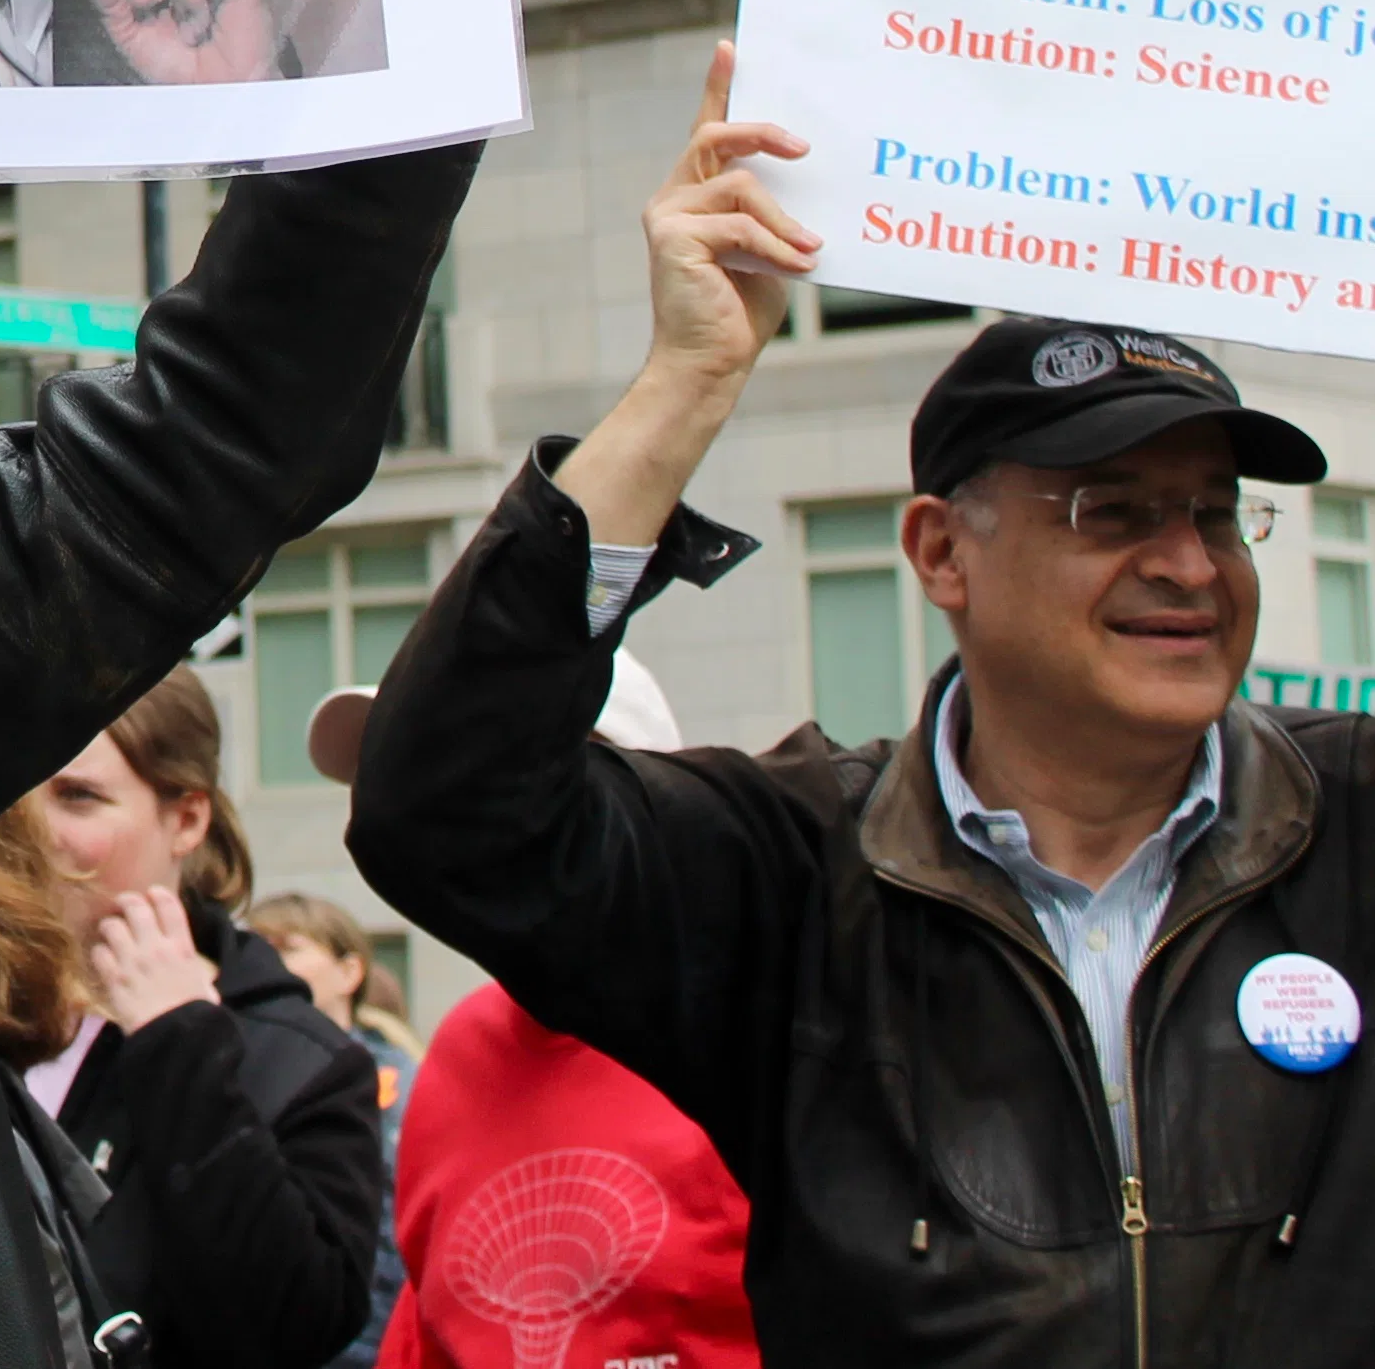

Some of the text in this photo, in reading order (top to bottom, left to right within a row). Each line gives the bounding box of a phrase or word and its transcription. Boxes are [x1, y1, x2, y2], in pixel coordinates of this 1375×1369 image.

[884, 12, 1332, 105] Solution: Science
[1282, 4, 1341, 43] of
[871, 138, 1111, 207] Problem:
[1130, 173, 1299, 233] World
[862, 204, 1375, 312] Solution: History a
[1280, 974, 1333, 984] PEOPLE
